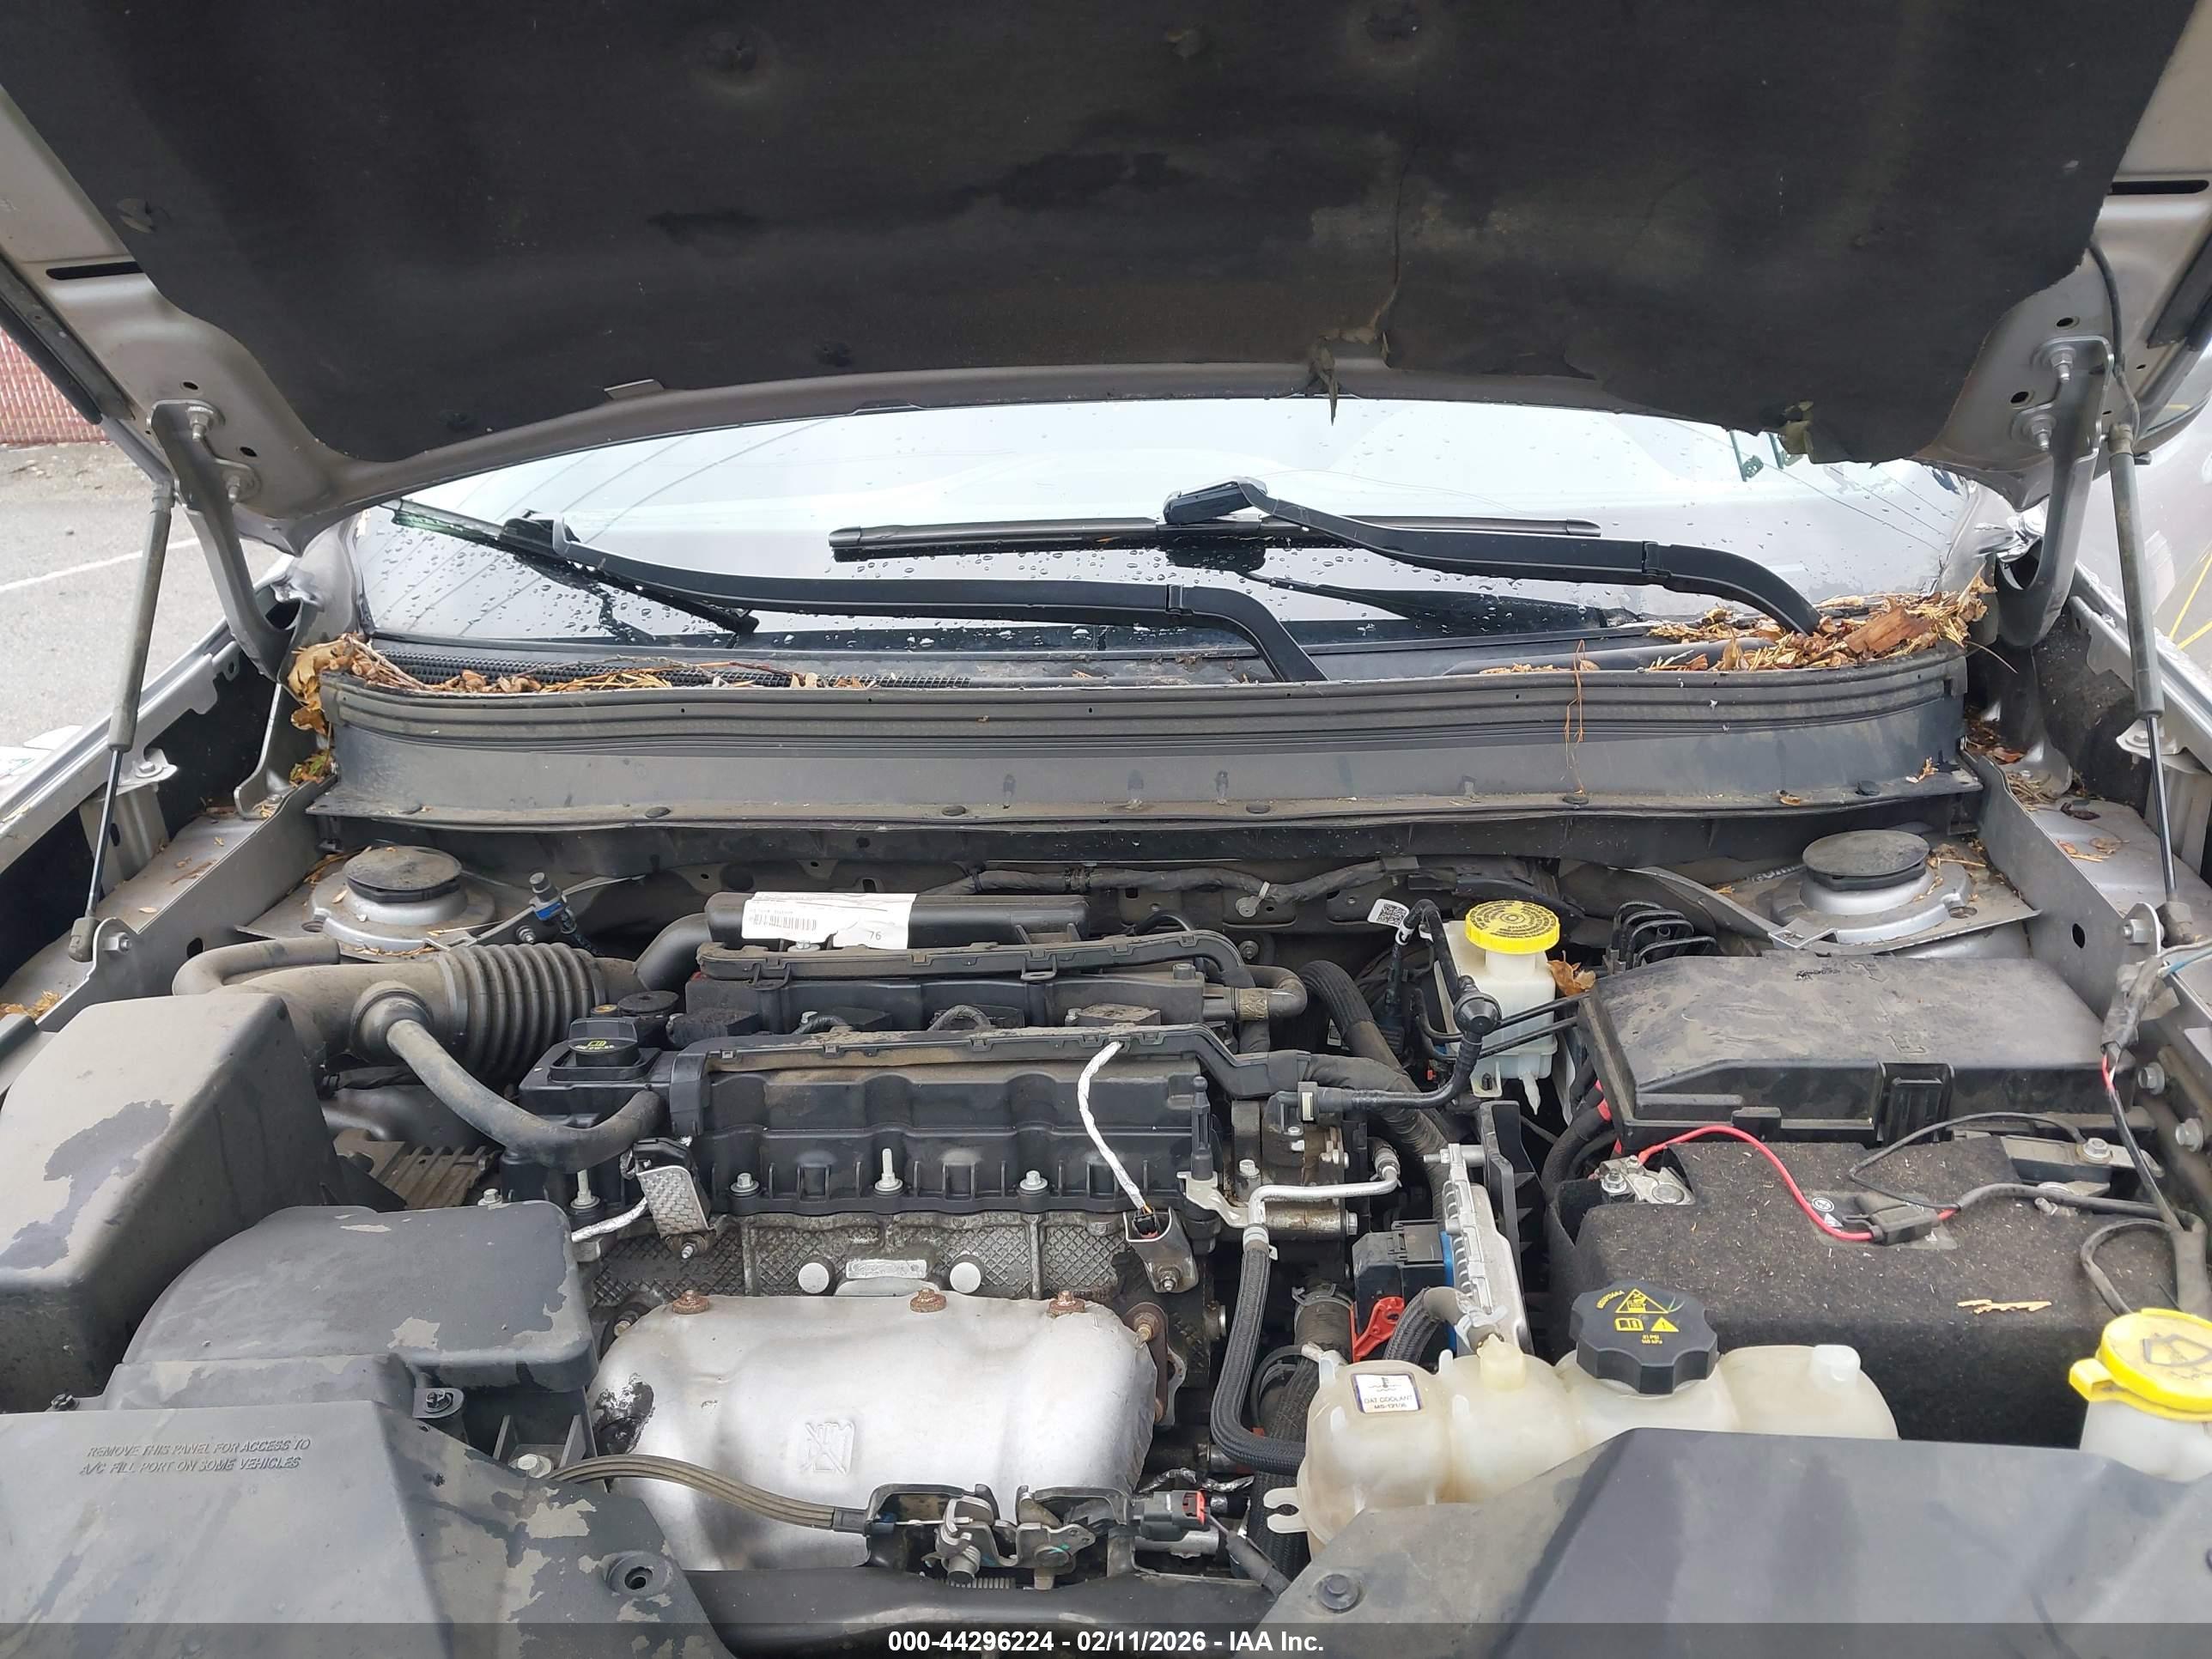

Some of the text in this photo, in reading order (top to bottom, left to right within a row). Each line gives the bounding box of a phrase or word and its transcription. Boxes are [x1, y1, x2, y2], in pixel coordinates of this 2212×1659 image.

[868, 931, 882, 941] 76
[1379, 1395, 1413, 1403] COOLANT
[87, 1438, 311, 1457] REMOVE THIS PANEL FOR ACCESS TO
[79, 1456, 301, 1475] A/C FILL PORT ON SOME VEHICLES
